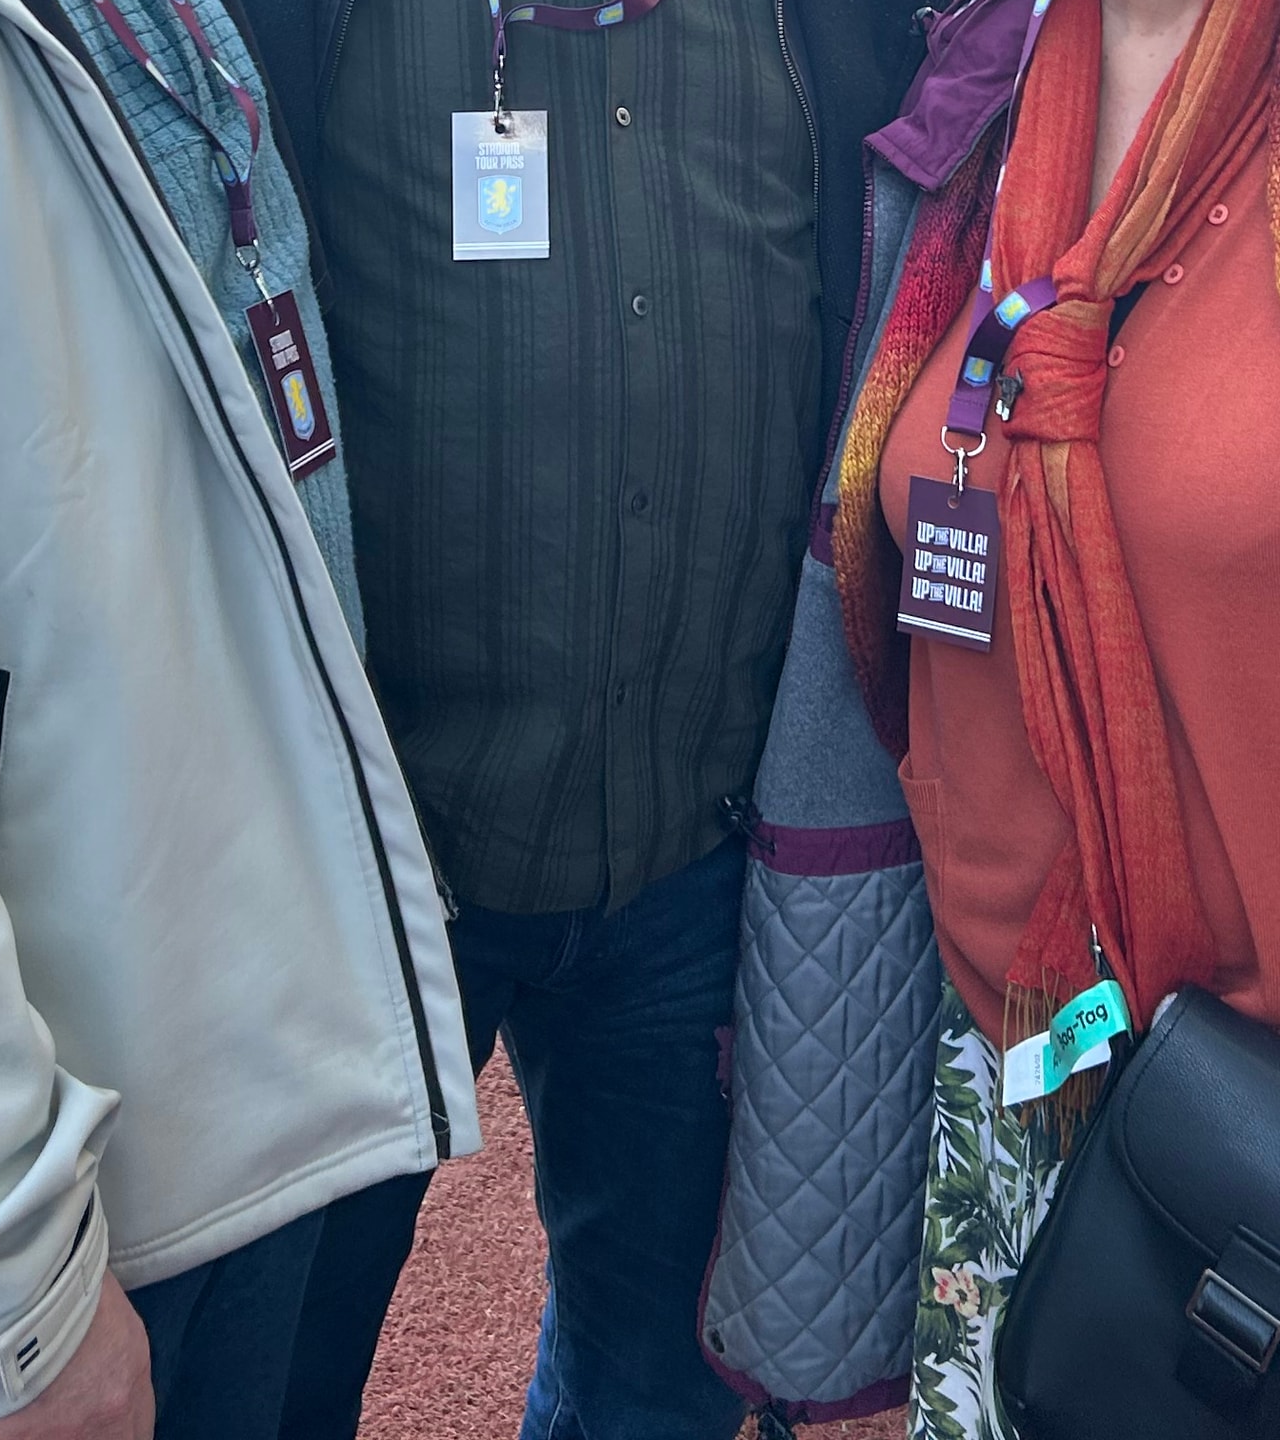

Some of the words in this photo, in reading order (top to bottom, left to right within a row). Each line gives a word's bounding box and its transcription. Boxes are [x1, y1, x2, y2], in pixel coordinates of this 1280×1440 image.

[475, 156, 498, 170] TOUR
[500, 156, 524, 169] PASS
[916, 521, 935, 543] UP
[949, 528, 989, 556] VILLA!
[914, 549, 933, 572] UP
[946, 555, 986, 584] VILLA!
[911, 576, 930, 600] UP
[944, 584, 983, 613] VILLA!
